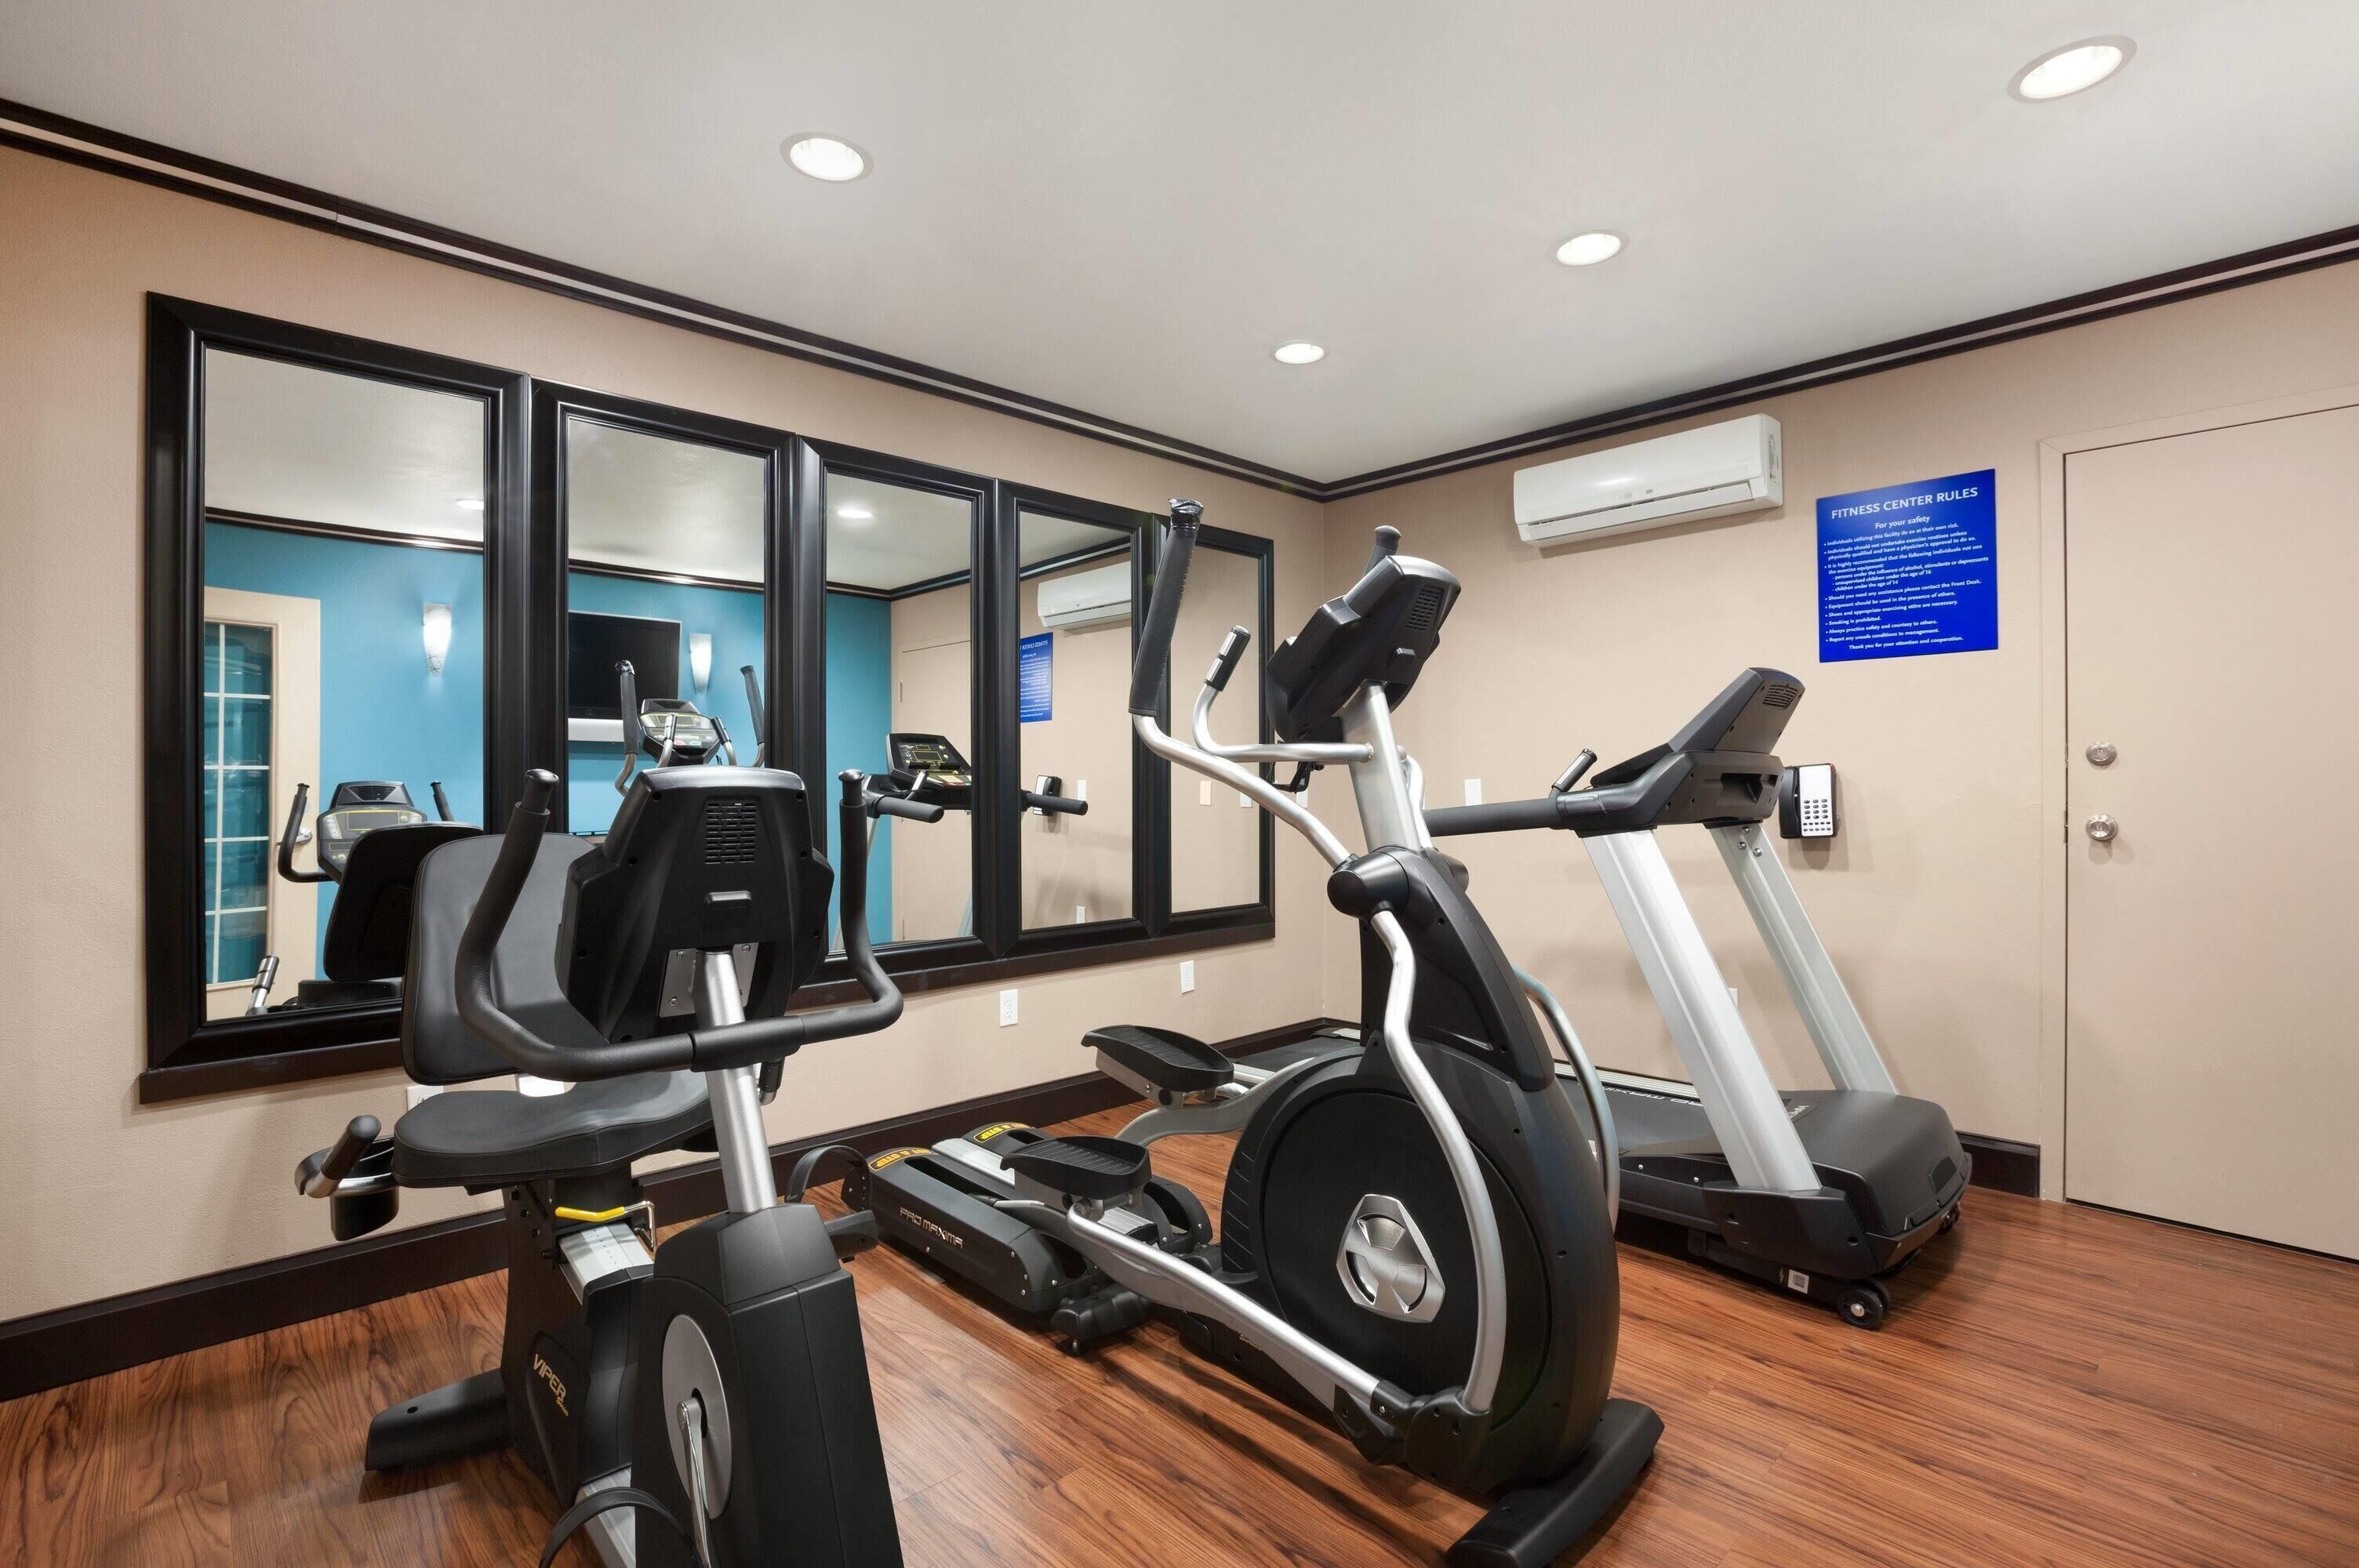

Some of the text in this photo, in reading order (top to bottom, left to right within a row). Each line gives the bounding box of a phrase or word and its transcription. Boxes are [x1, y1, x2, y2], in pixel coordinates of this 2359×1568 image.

[1831, 487, 1978, 519] FITNESS CENTER RULES
[1888, 519, 1906, 528] your
[1907, 514, 1930, 525] safety
[1853, 535, 1873, 543] utilizing
[1826, 546, 1852, 554] Individuals
[1827, 552, 1851, 561] physically
[1929, 539, 1952, 547] approval
[1852, 556, 1887, 565] recommended
[1908, 550, 1932, 559] following
[1957, 556, 1989, 565] depressants
[1834, 577, 1865, 586] unsupervised
[1828, 601, 1853, 610] Equipment
[1881, 604, 1906, 613] exercising
[1788, 1105, 1810, 1118] VIPE
[877, 1153, 901, 1167] STEP
[900, 1207, 963, 1249] PRO MAXIMA
[533, 1353, 566, 1402] VIPER
